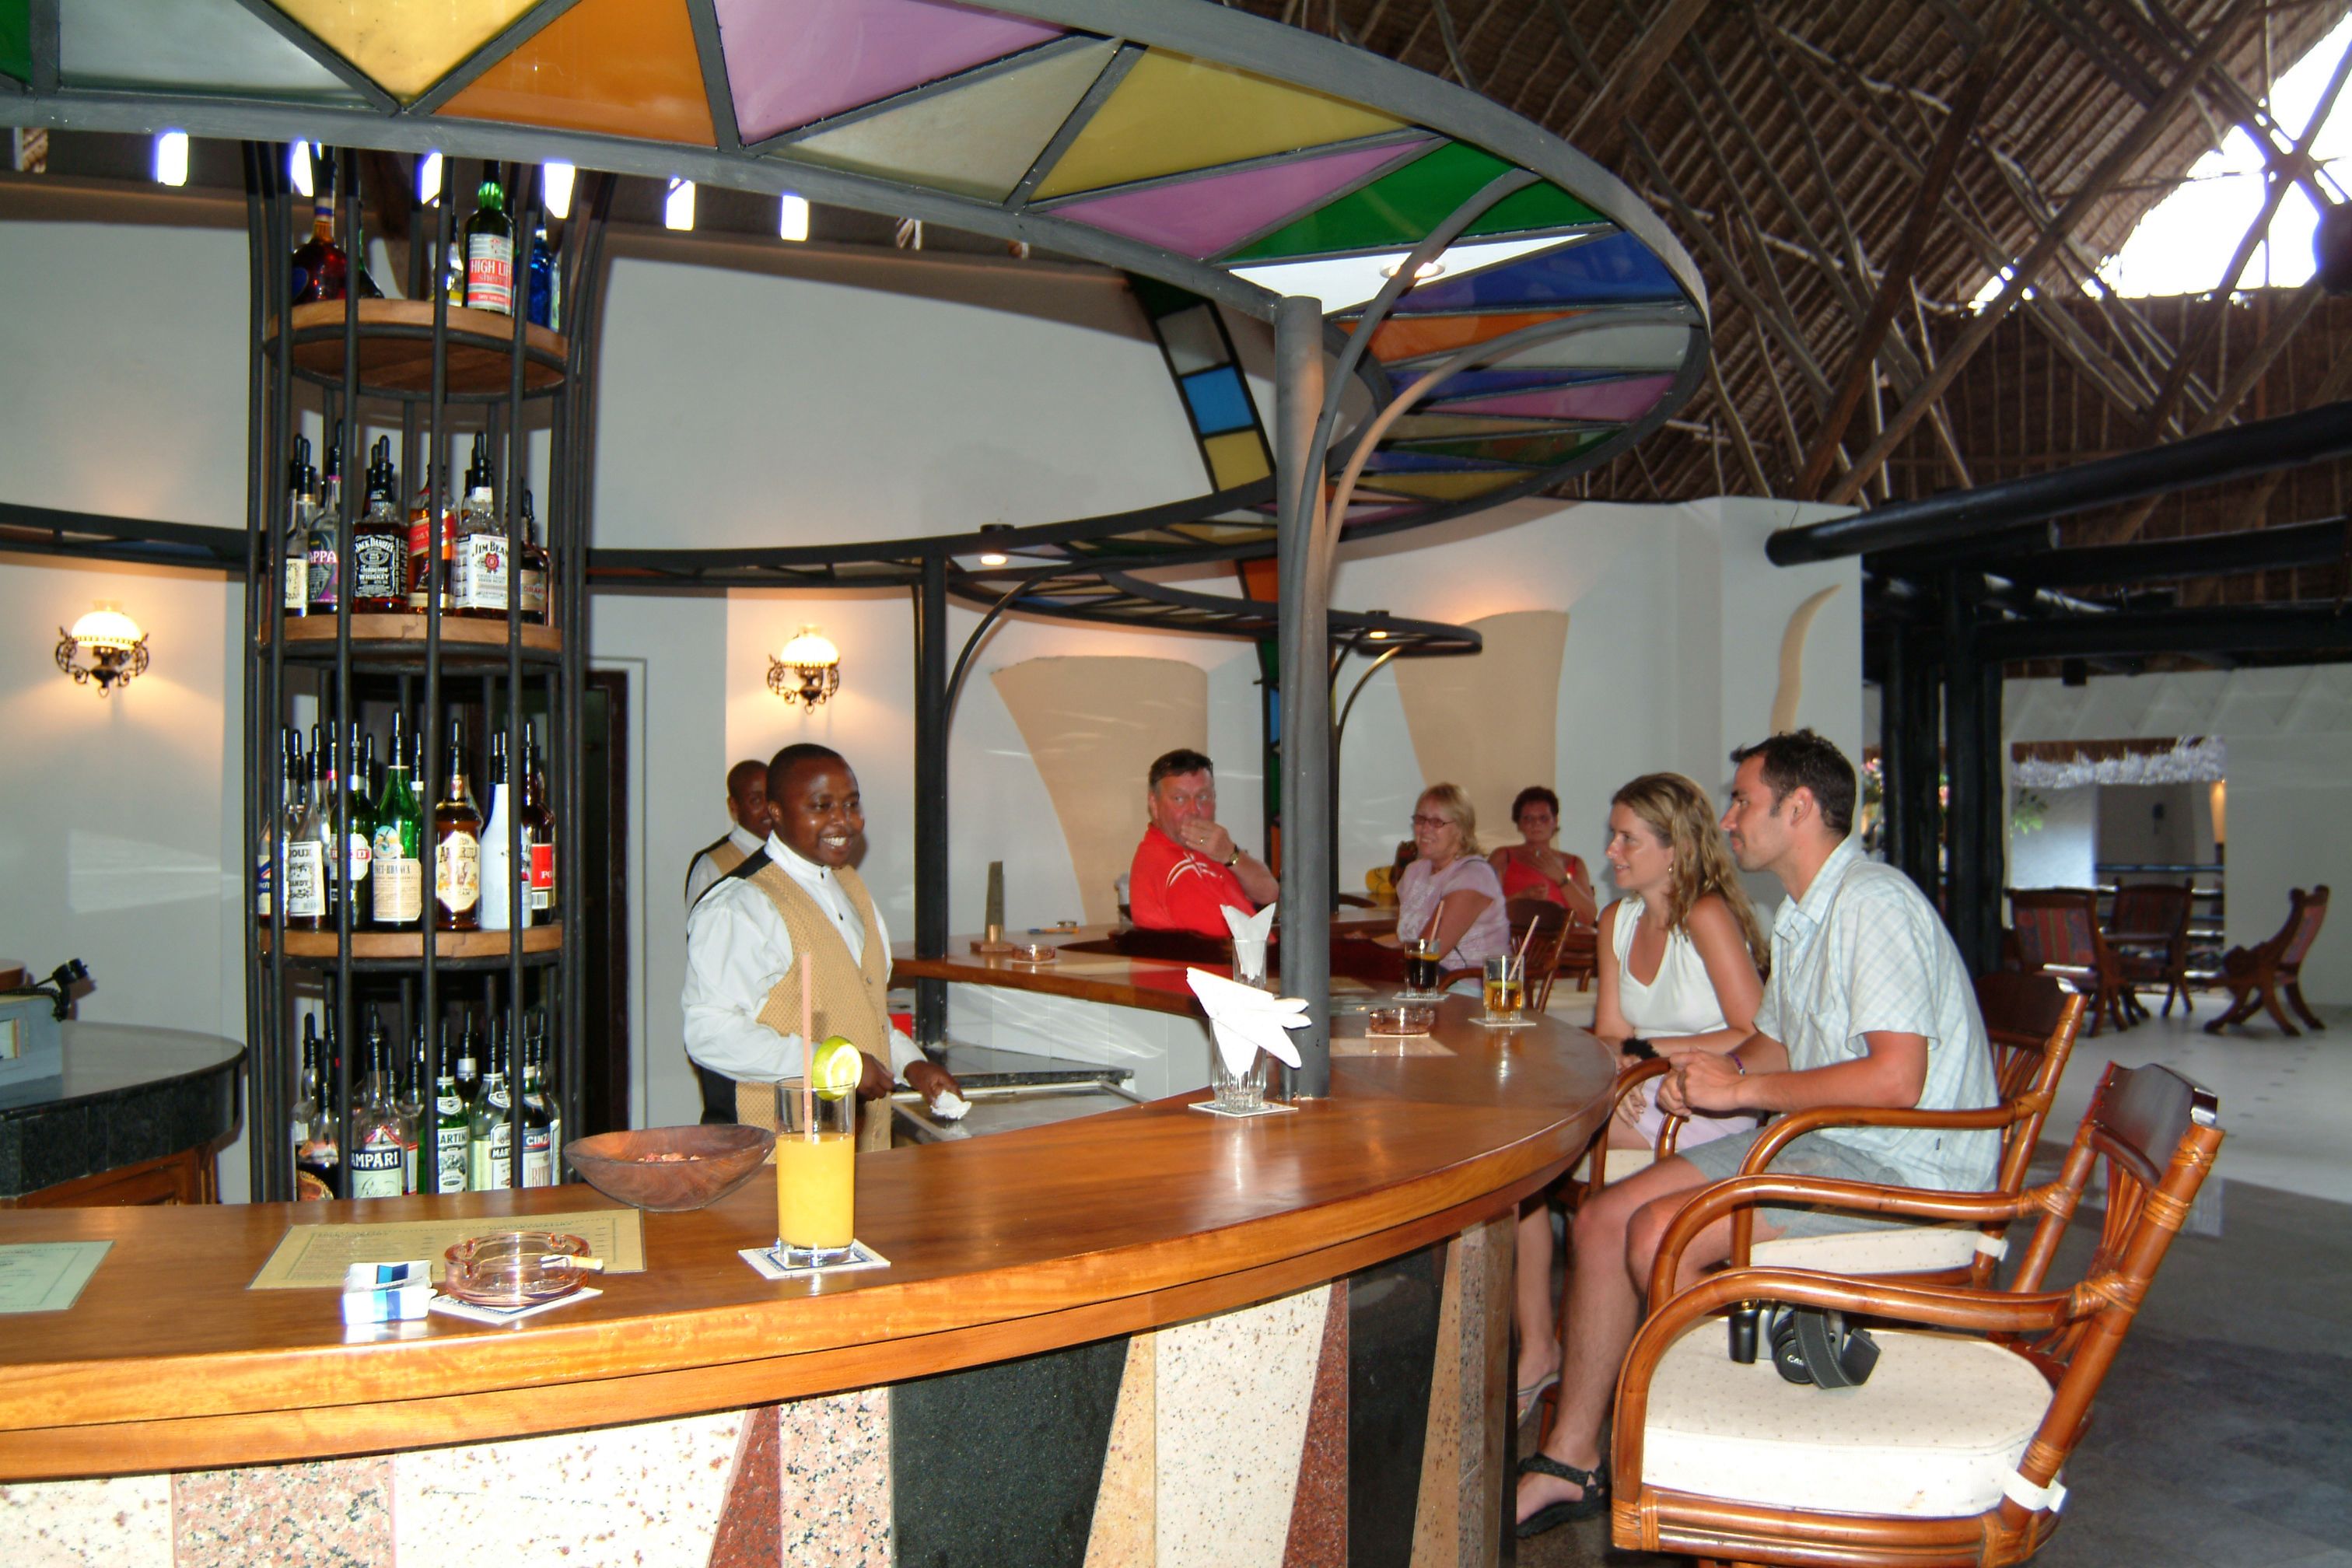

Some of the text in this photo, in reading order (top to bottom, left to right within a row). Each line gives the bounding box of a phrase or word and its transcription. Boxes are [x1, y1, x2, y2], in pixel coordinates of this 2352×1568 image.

[471, 259, 495, 274] HIGH
[355, 540, 370, 553] JACK
[471, 543, 488, 557] JIM
